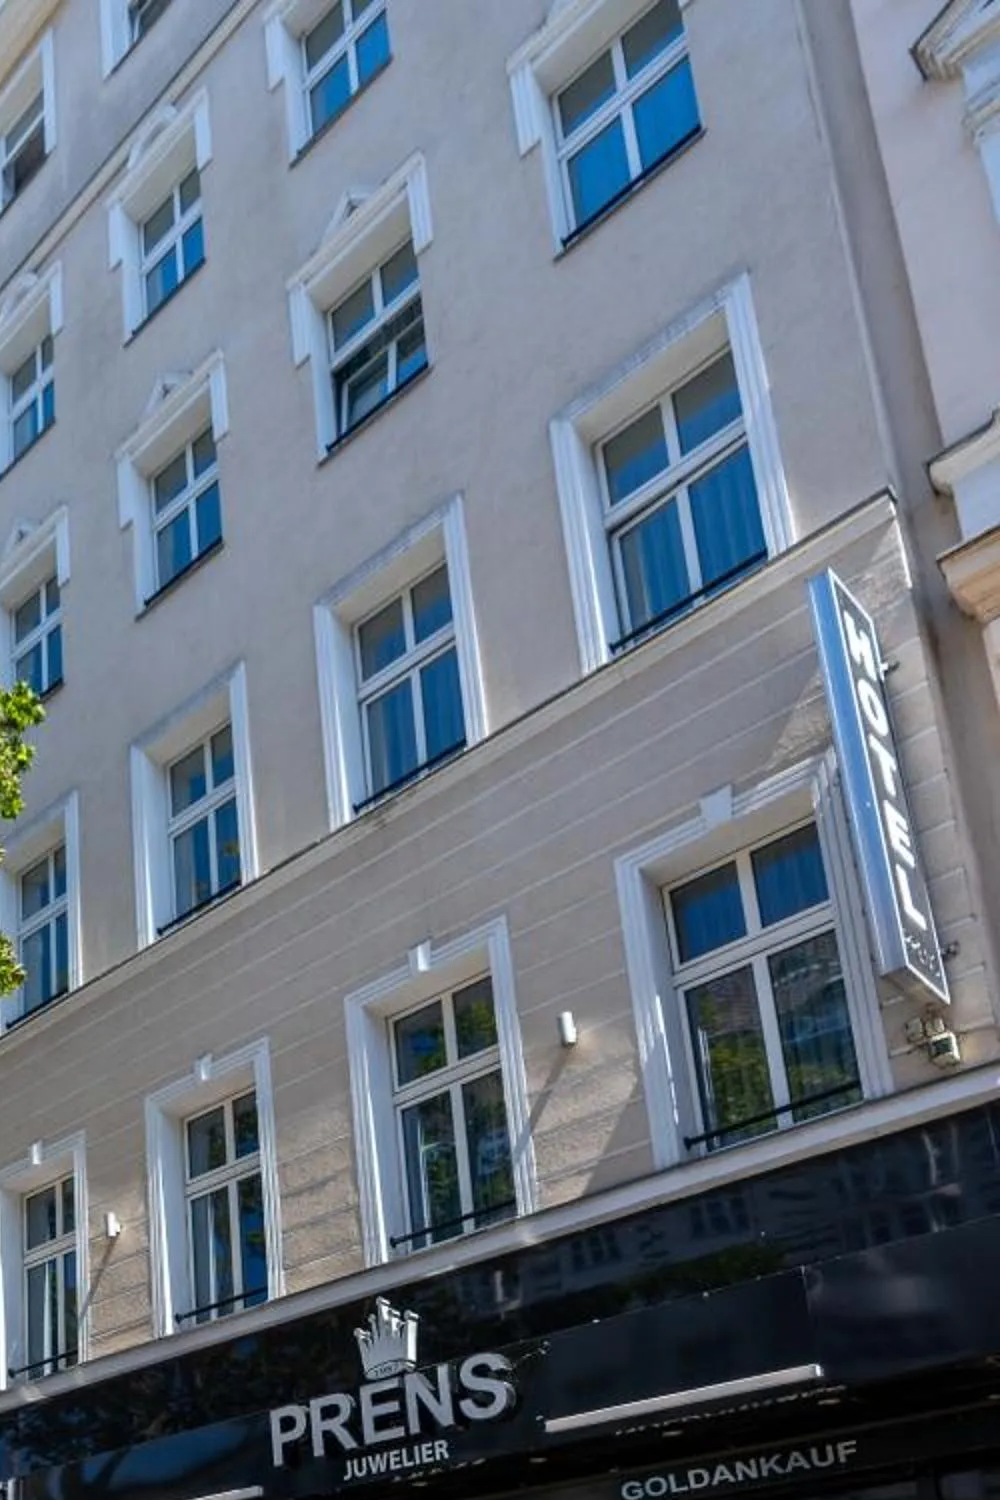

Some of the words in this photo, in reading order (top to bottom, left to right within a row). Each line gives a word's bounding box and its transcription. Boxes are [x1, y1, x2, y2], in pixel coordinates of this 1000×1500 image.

[843, 611, 927, 930] HOTEL
[270, 1353, 513, 1467] PRENS
[343, 1440, 449, 1481] JUWELIER
[621, 1440, 856, 1500] GOLDANKAUF
